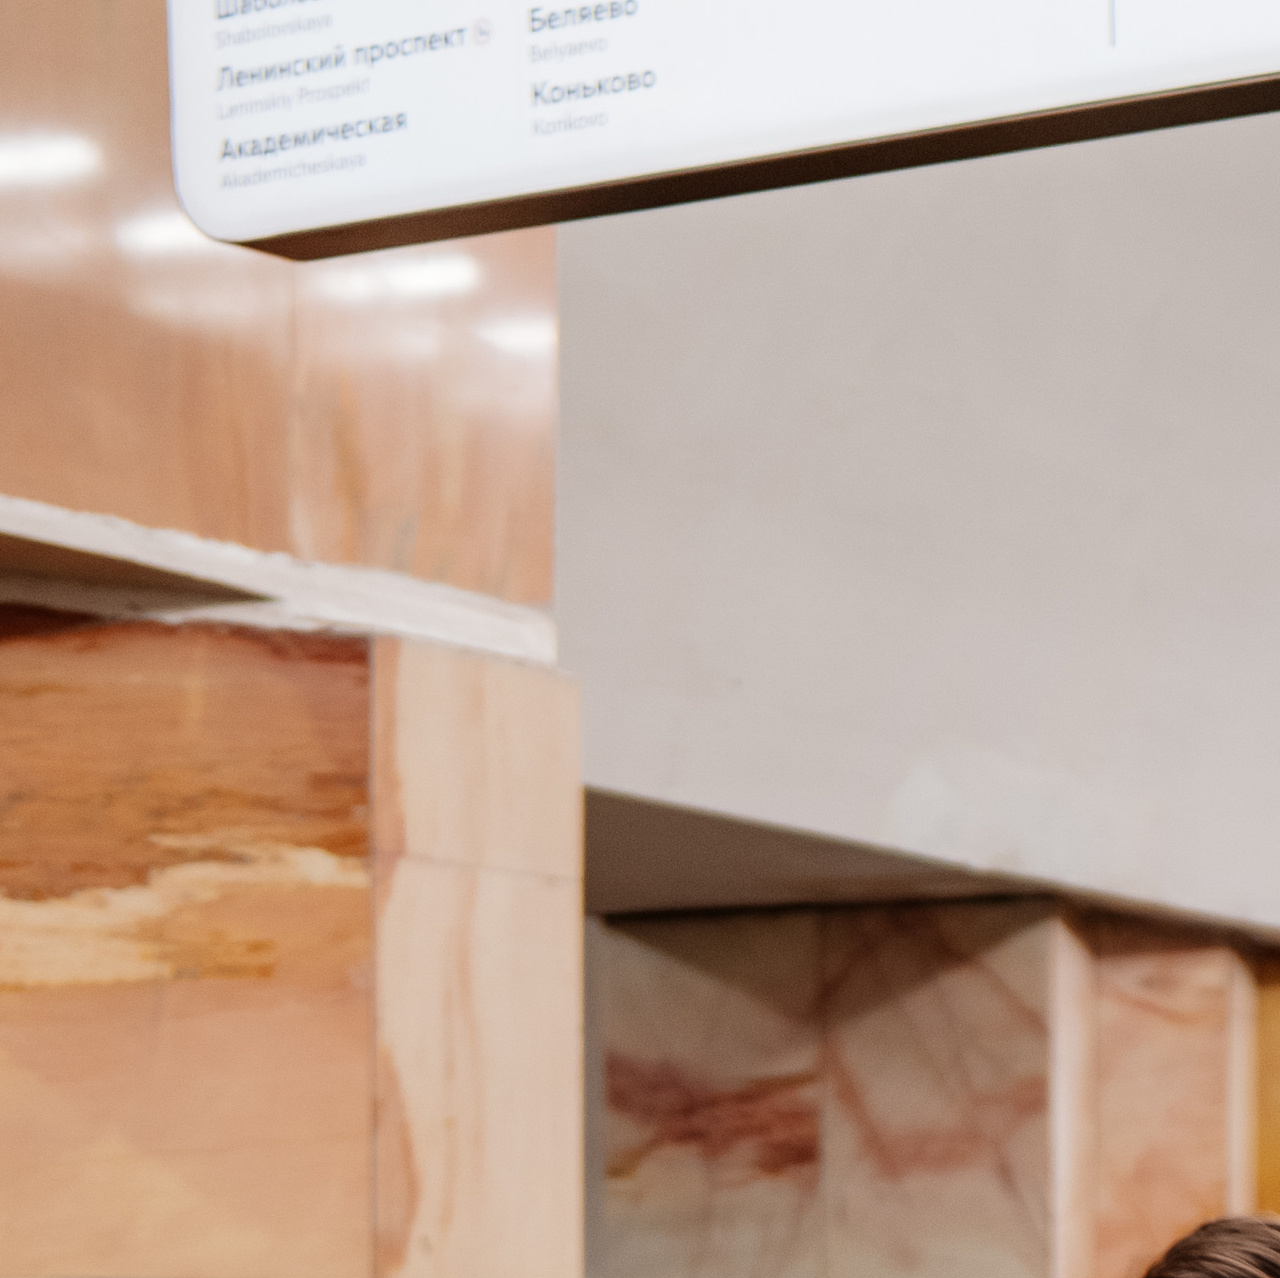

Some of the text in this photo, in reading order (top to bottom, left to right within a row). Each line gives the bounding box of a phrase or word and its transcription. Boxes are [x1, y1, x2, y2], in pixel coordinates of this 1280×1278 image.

[528, 0, 639, 33] Беляево
[215, 43, 347, 91] Ленинский
[354, 25, 467, 69] проспект
[531, 68, 657, 107] Коньково
[217, 110, 408, 163] Академическая
